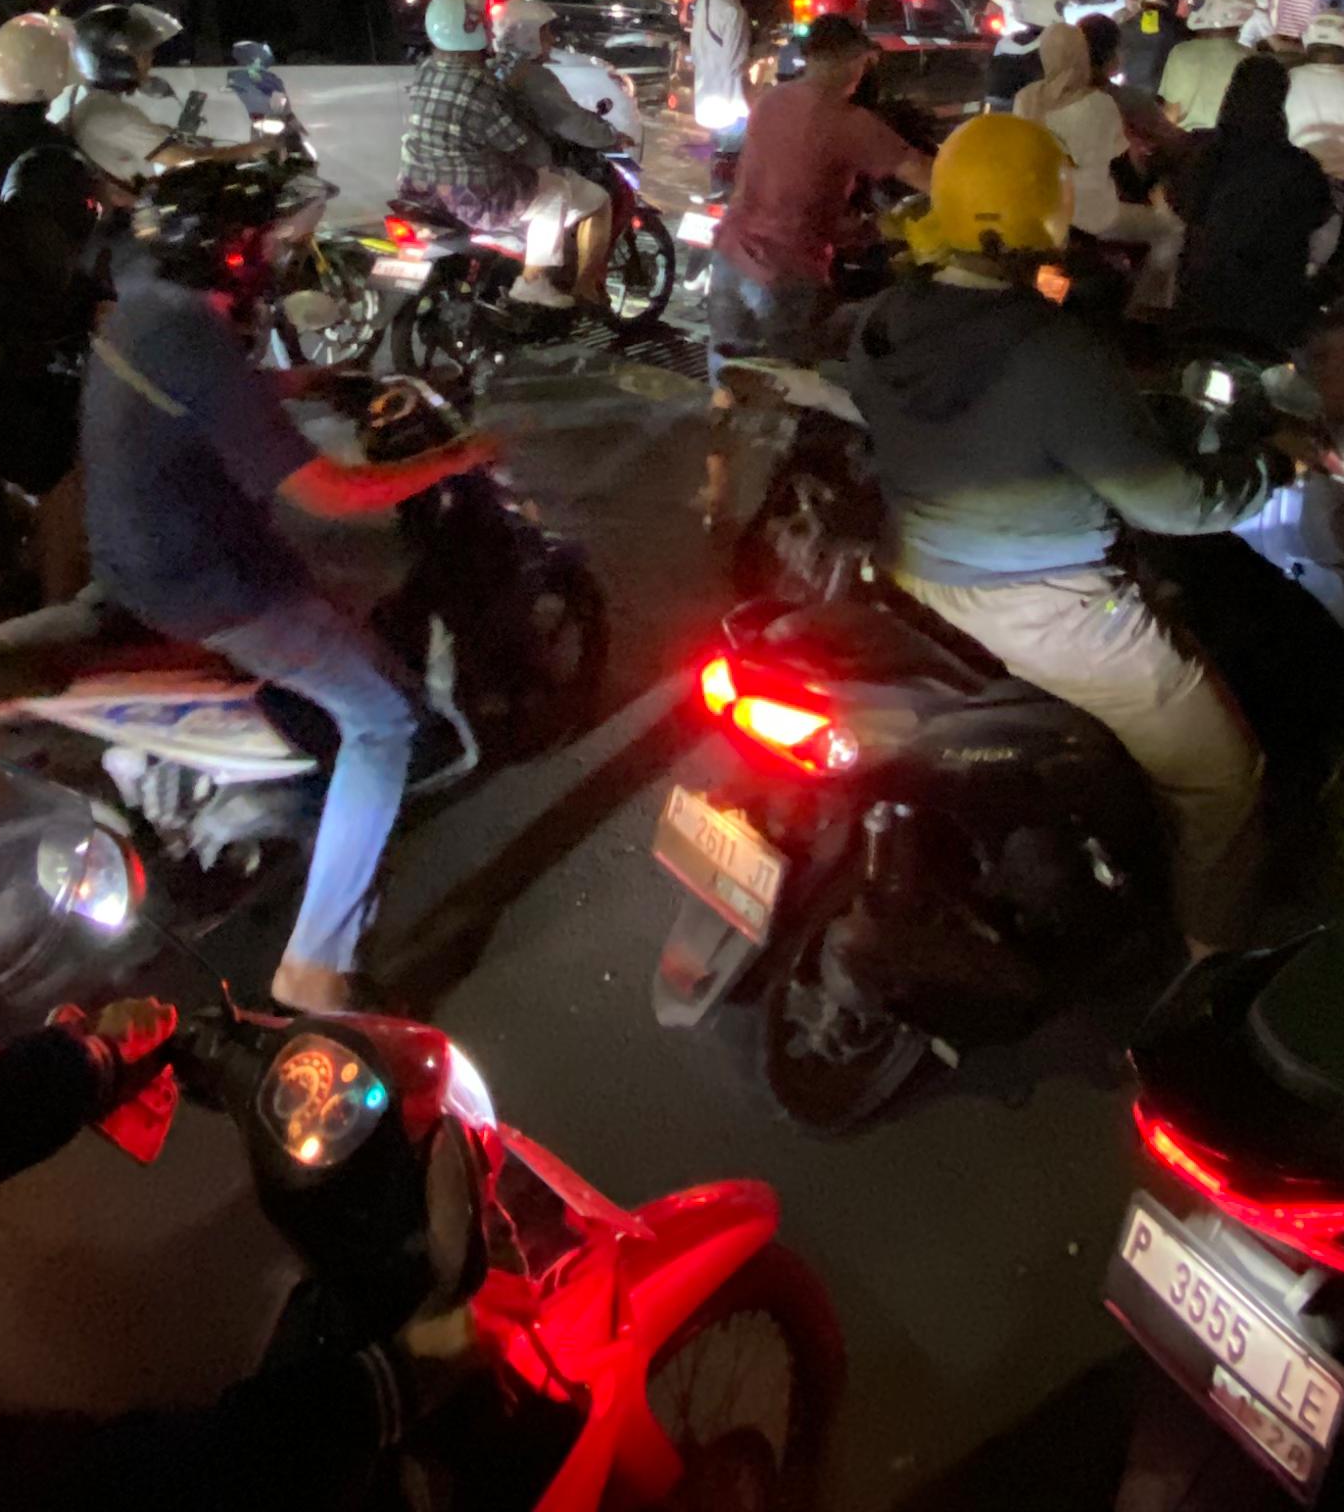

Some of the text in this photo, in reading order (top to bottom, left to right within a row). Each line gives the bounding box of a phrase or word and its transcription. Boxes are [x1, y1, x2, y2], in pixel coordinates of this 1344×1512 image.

[1129, 1221, 1329, 1432] P 3555 LE
